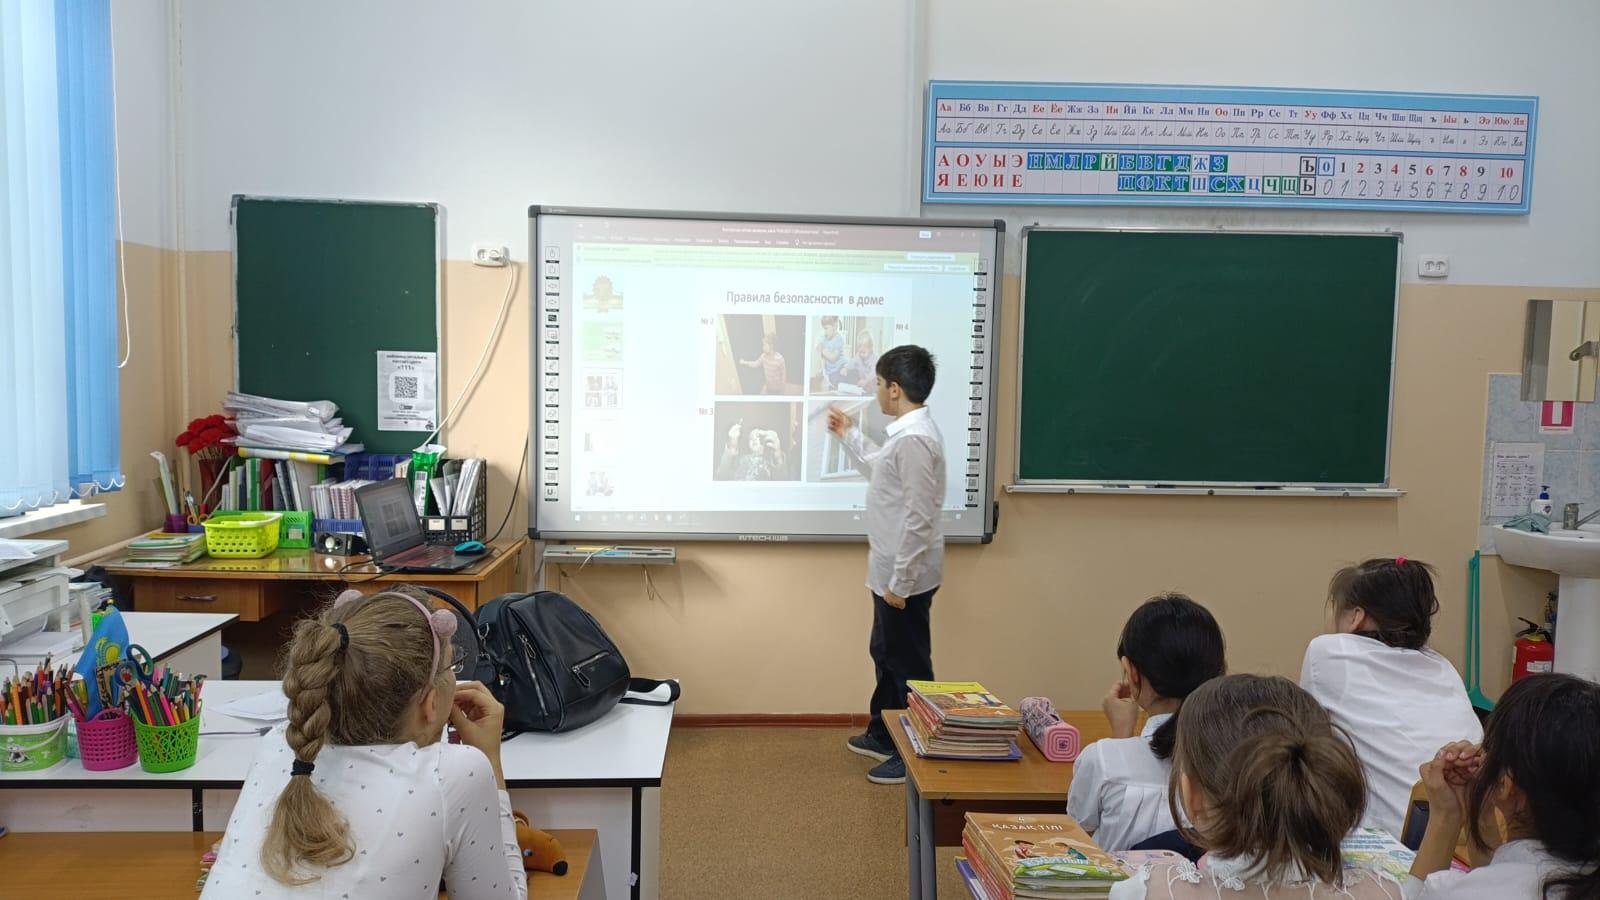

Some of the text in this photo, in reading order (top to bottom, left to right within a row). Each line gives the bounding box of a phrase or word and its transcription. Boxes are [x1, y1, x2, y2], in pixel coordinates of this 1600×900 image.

[939, 103, 952, 111] Аа
[959, 104, 971, 112] Бб
[977, 104, 990, 112] Вв
[996, 104, 1008, 112] Гг
[1013, 105, 1026, 114] Дд
[1087, 106, 1099, 114] Зз
[1105, 106, 1118, 114] Ии
[1123, 105, 1137, 114] Йй
[1142, 107, 1154, 115] Кк
[1159, 107, 1174, 115] Лл
[1178, 107, 1193, 115] Мм
[1232, 108, 1246, 116] Пп
[1251, 109, 1264, 119] Рр
[1268, 109, 1281, 117] Сс
[1304, 110, 1317, 120] Уу
[1320, 111, 1336, 121] Фф
[1340, 112, 1352, 120] Хх
[1375, 113, 1388, 121] Чч
[1391, 113, 1406, 121] Шш
[1443, 115, 1457, 123] Ыы
[1479, 116, 1491, 125] Ээ
[1494, 116, 1510, 125] Юю
[938, 153, 1513, 178] А О У Ы Э Н М Л Р Й Б В Г Д Ж З Ъ 0 1 2 3 4 5 6 7 8 9 10
[937, 174, 1519, 200] Я Е Ю И Е П Ф К Т Ш С Х Ц Ч Щ Ь 0 1 2 3 4 5 6 7 8 9 10
[726, 292, 884, 307] Правила безопасности в доме
